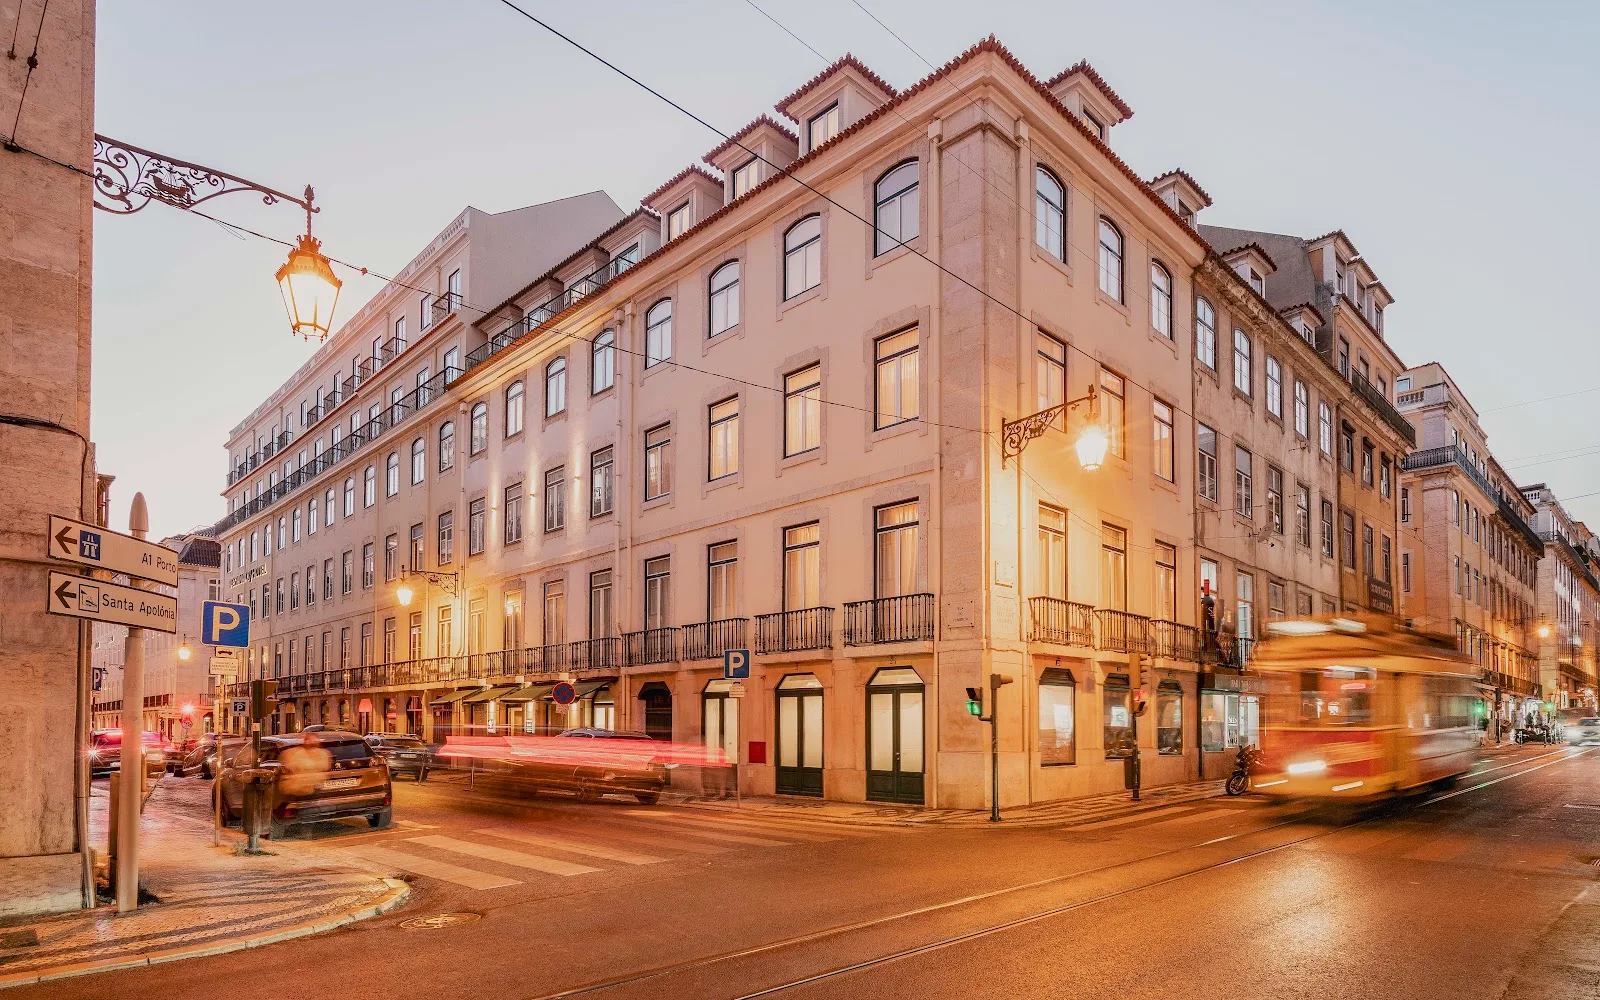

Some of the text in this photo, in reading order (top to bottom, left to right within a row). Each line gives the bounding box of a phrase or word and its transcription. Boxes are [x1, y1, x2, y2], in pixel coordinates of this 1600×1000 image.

[141, 552, 177, 574] A1 Porto
[102, 593, 175, 620] Santa Apolónia
[211, 605, 240, 642] P
[729, 652, 744, 676] P
[94, 669, 100, 690] P
[236, 703, 244, 712] P
